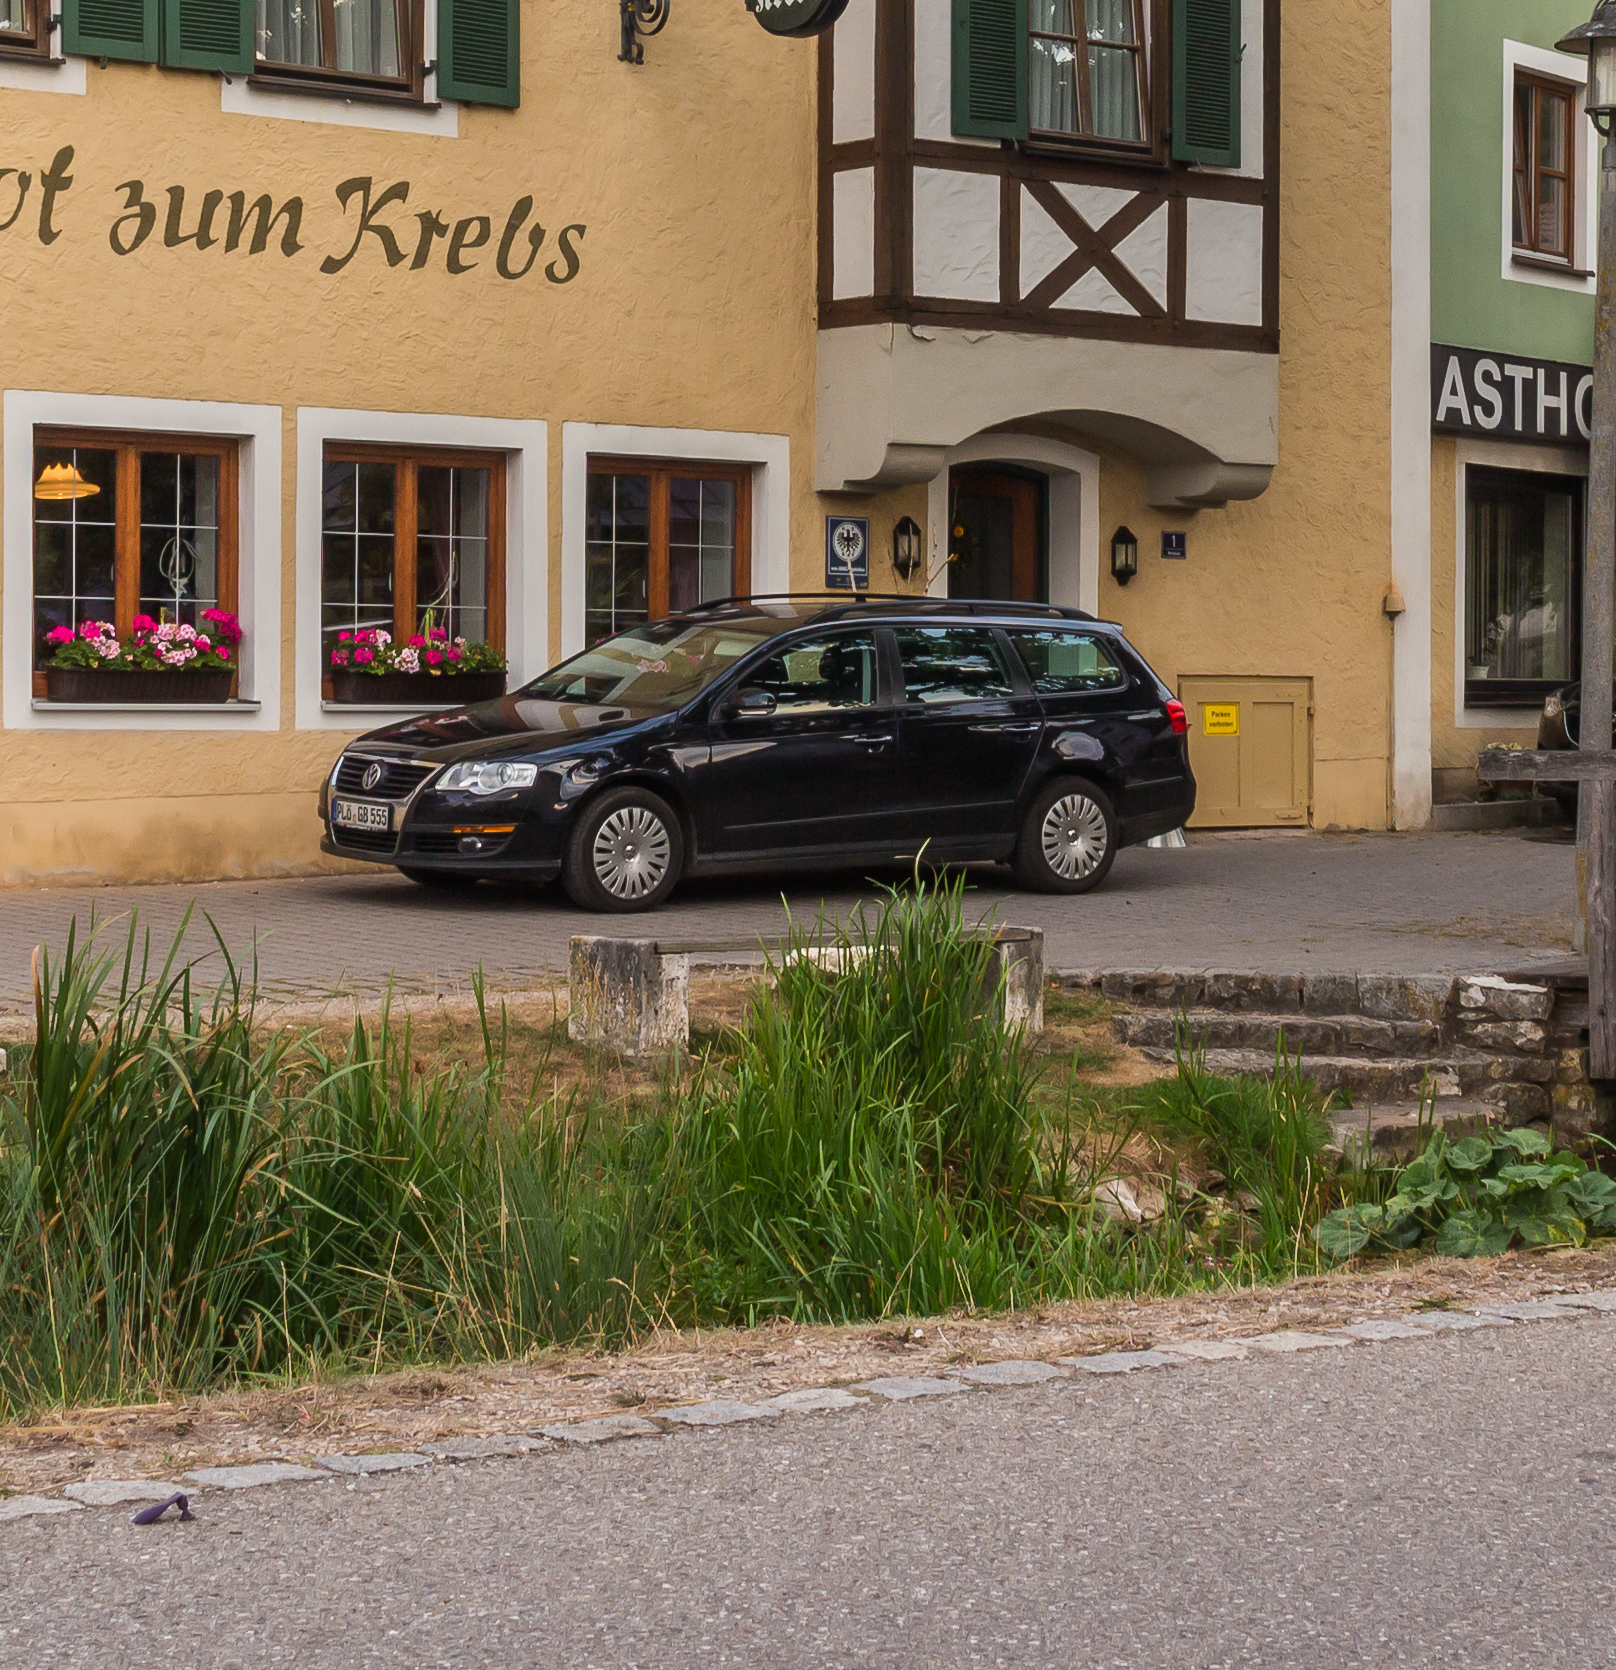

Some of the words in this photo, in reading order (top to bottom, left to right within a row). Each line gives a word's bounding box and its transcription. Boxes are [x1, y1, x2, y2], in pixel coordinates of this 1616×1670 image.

[109, 178, 306, 256] zum
[318, 175, 588, 285] Krebs
[1171, 534, 1177, 548] 1
[357, 805, 369, 824] GB
